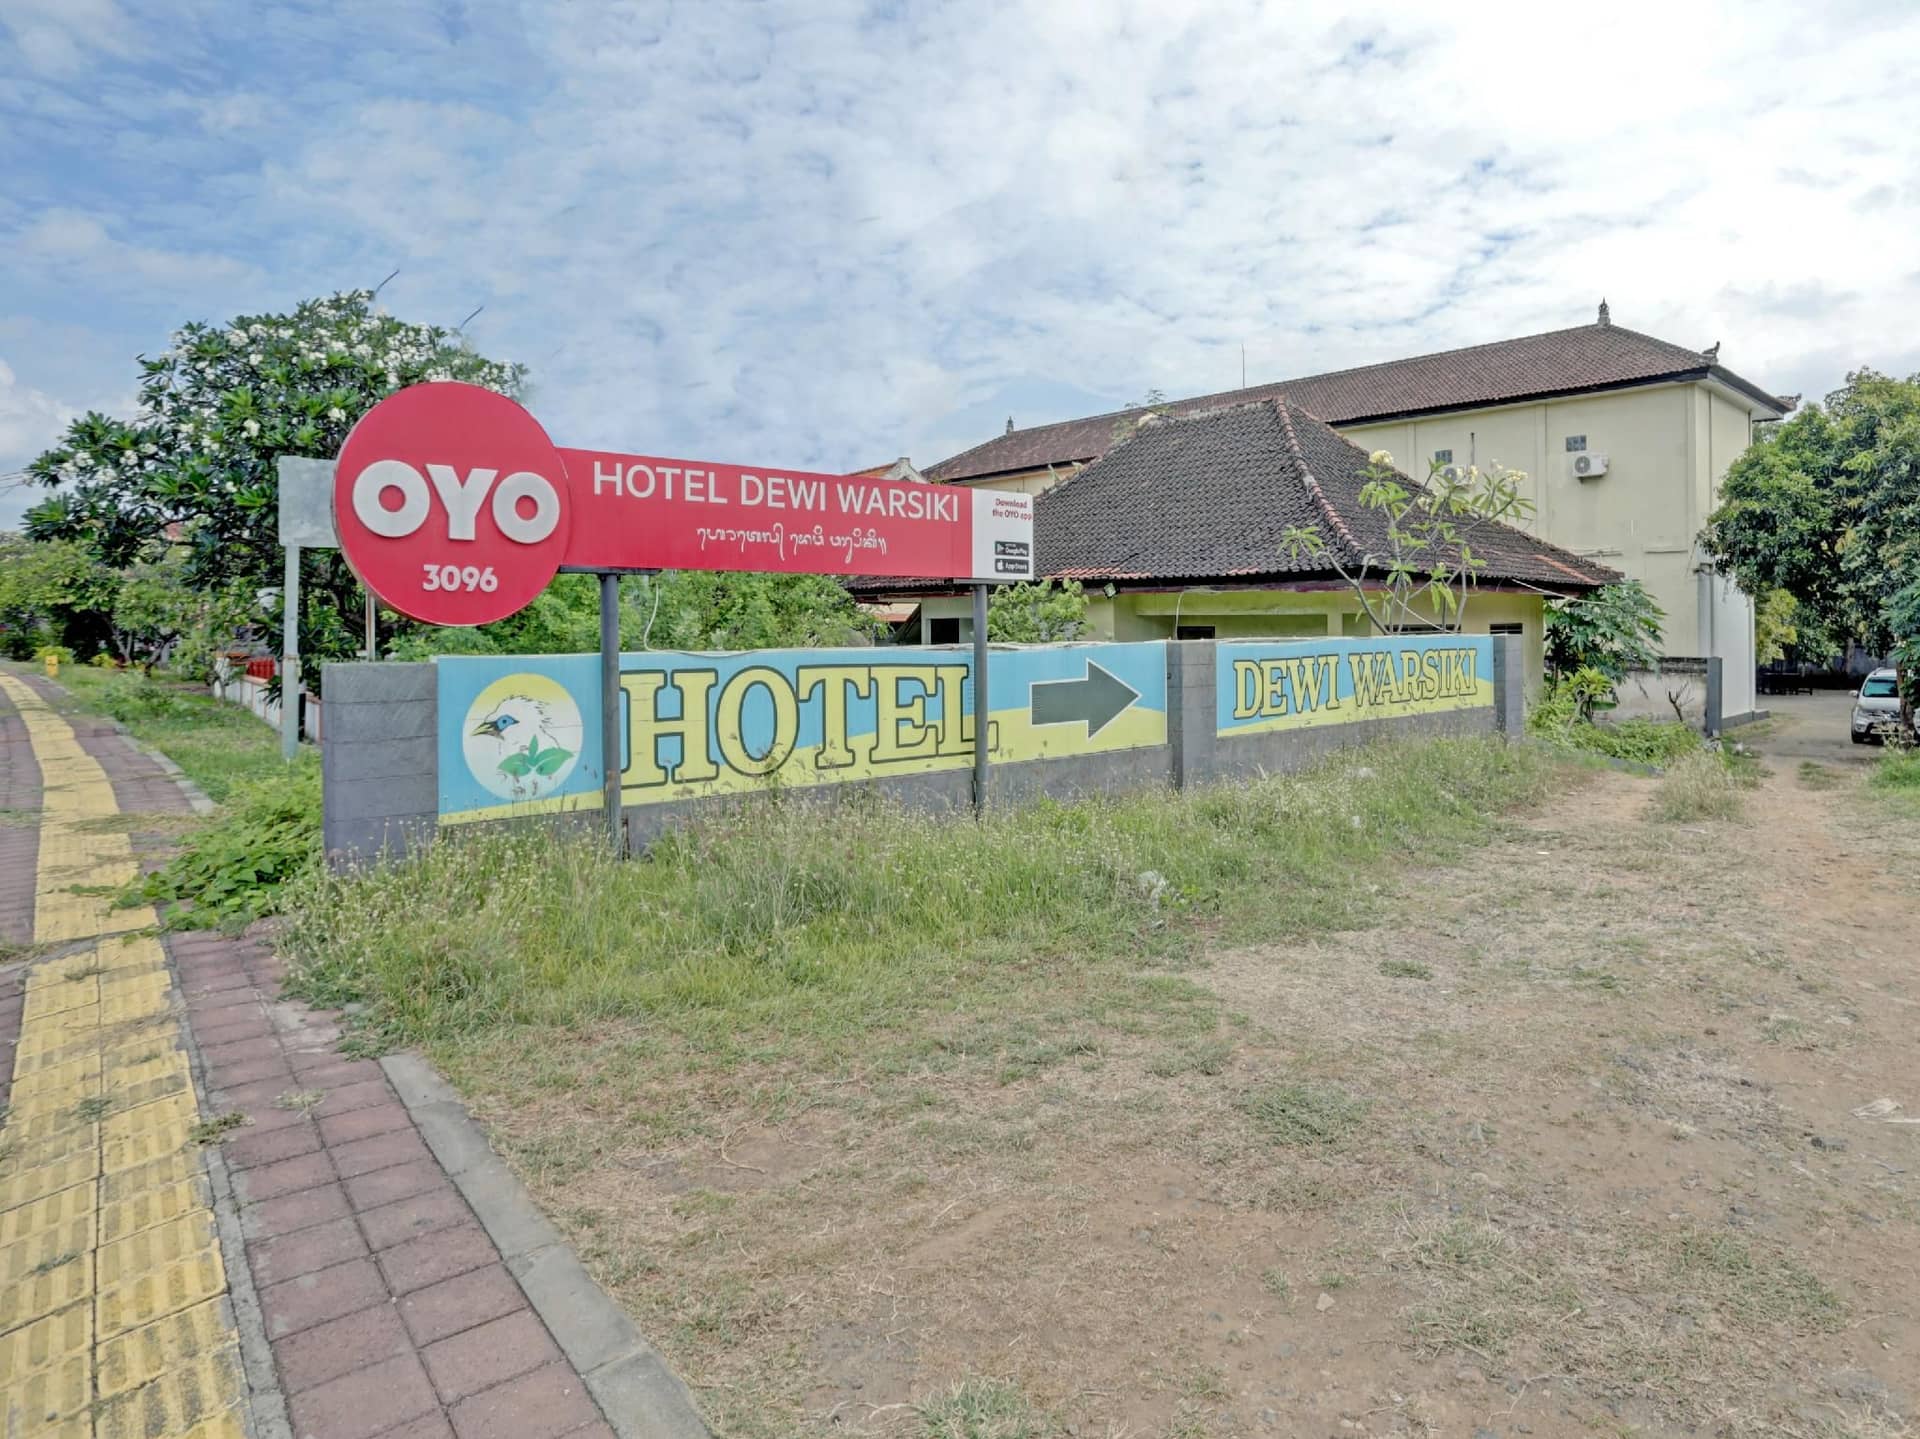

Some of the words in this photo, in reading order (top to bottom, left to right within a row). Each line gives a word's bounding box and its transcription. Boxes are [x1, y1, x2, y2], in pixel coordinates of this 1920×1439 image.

[352, 460, 560, 544] OYO
[593, 460, 728, 504] HOTEL
[740, 473, 826, 512] DEWI
[836, 483, 959, 522] WARSIKI
[992, 509, 1003, 518] the
[1004, 510, 1019, 519] OYO
[1020, 512, 1032, 521] app
[995, 498, 1028, 509] Download
[422, 564, 498, 593] 3096
[1232, 653, 1342, 721] DEWI
[1347, 647, 1479, 707] WARSIKI
[619, 664, 999, 790] HOTEL
